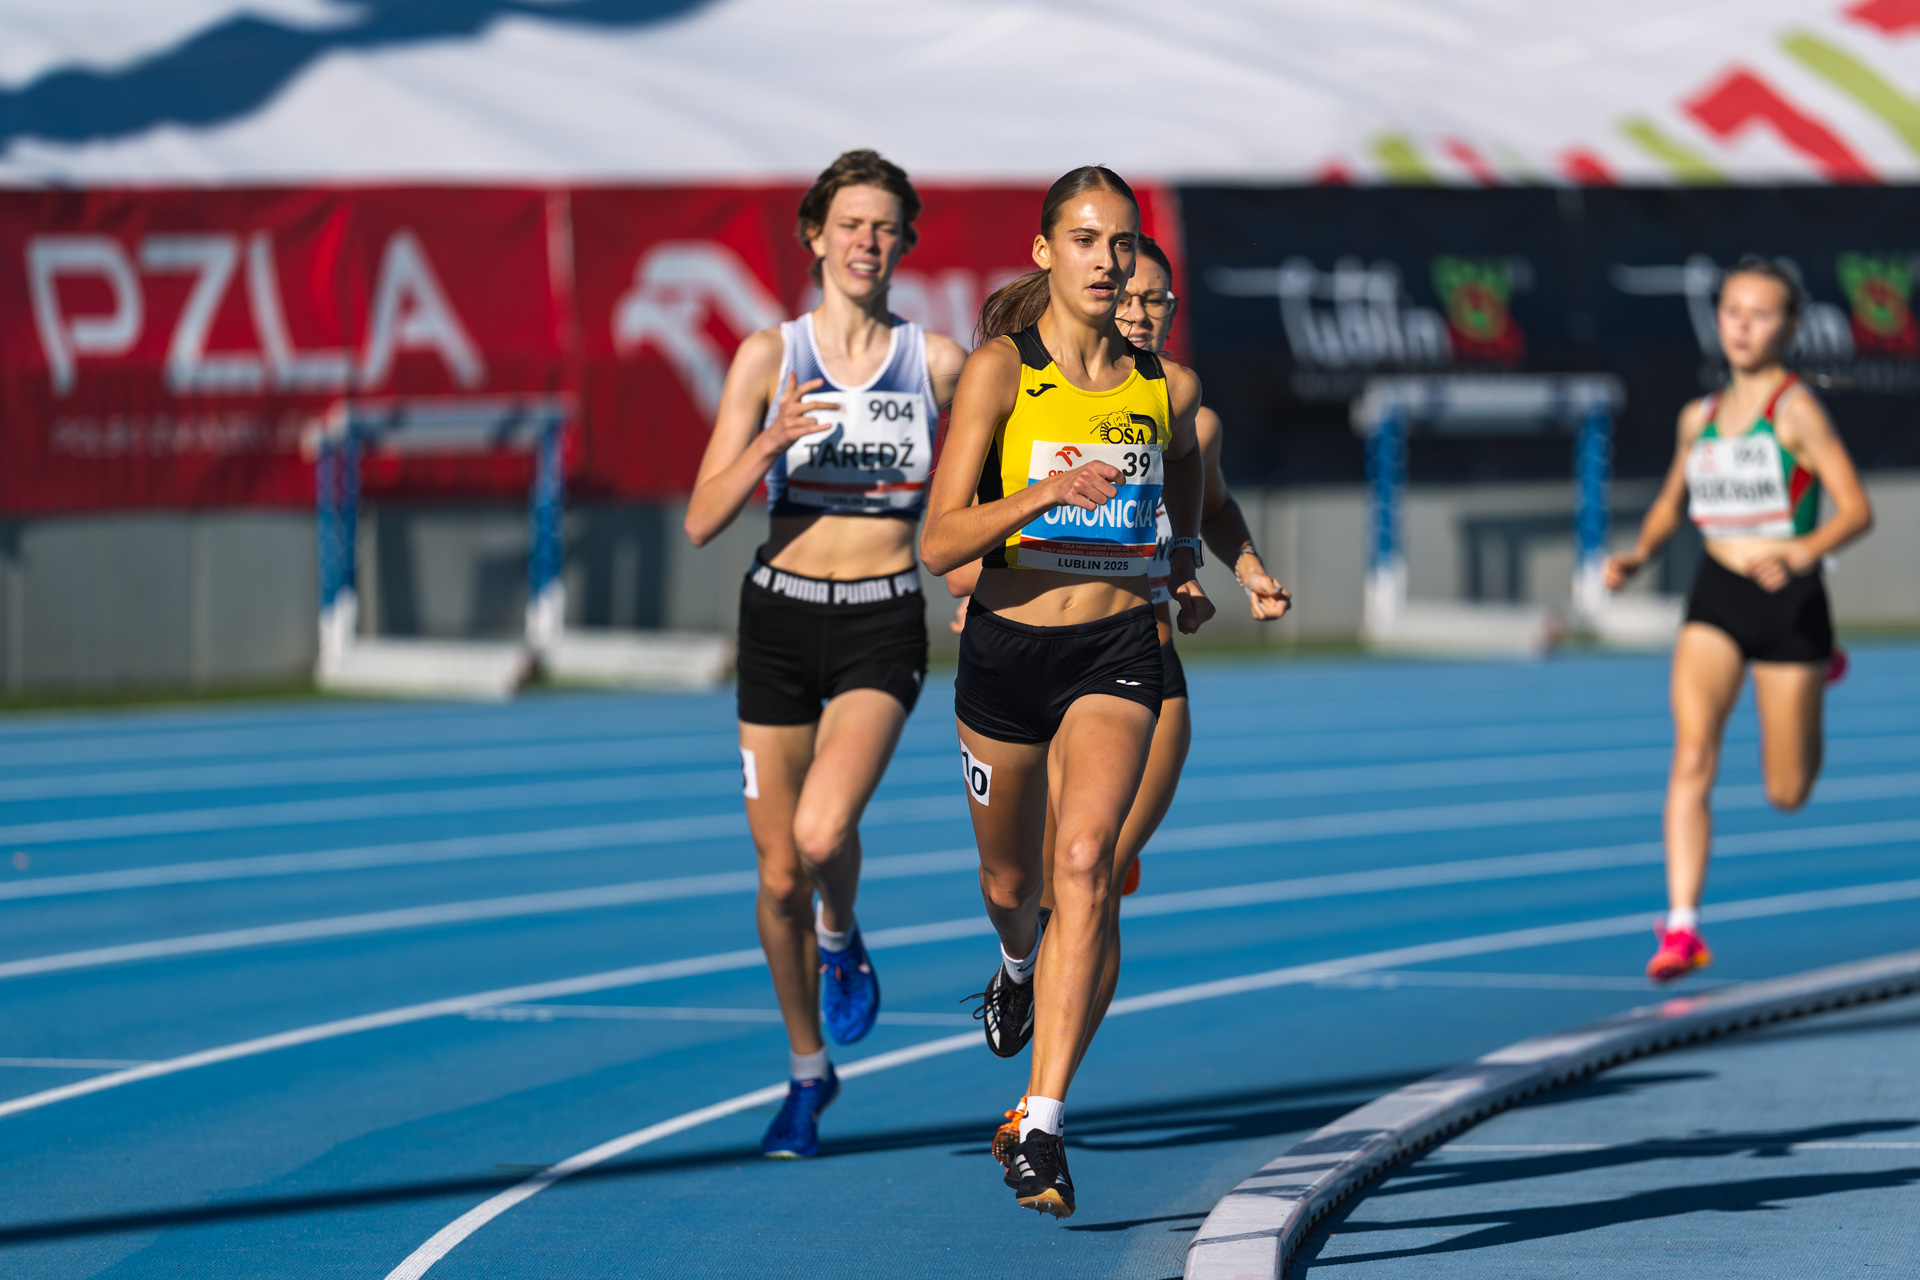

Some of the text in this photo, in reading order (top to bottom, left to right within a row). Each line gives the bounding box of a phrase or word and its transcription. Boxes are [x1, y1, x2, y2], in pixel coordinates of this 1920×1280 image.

[26, 230, 487, 396] PZLA
[869, 399, 914, 422] 904
[1106, 426, 1146, 445] OSA
[803, 437, 915, 474] TARĘDŹ
[1121, 452, 1151, 478] 39
[1057, 558, 1129, 571] LUBLIN 2025
[772, 572, 830, 604] PUMA
[833, 578, 893, 605] PUMA
[961, 751, 988, 796] 10
